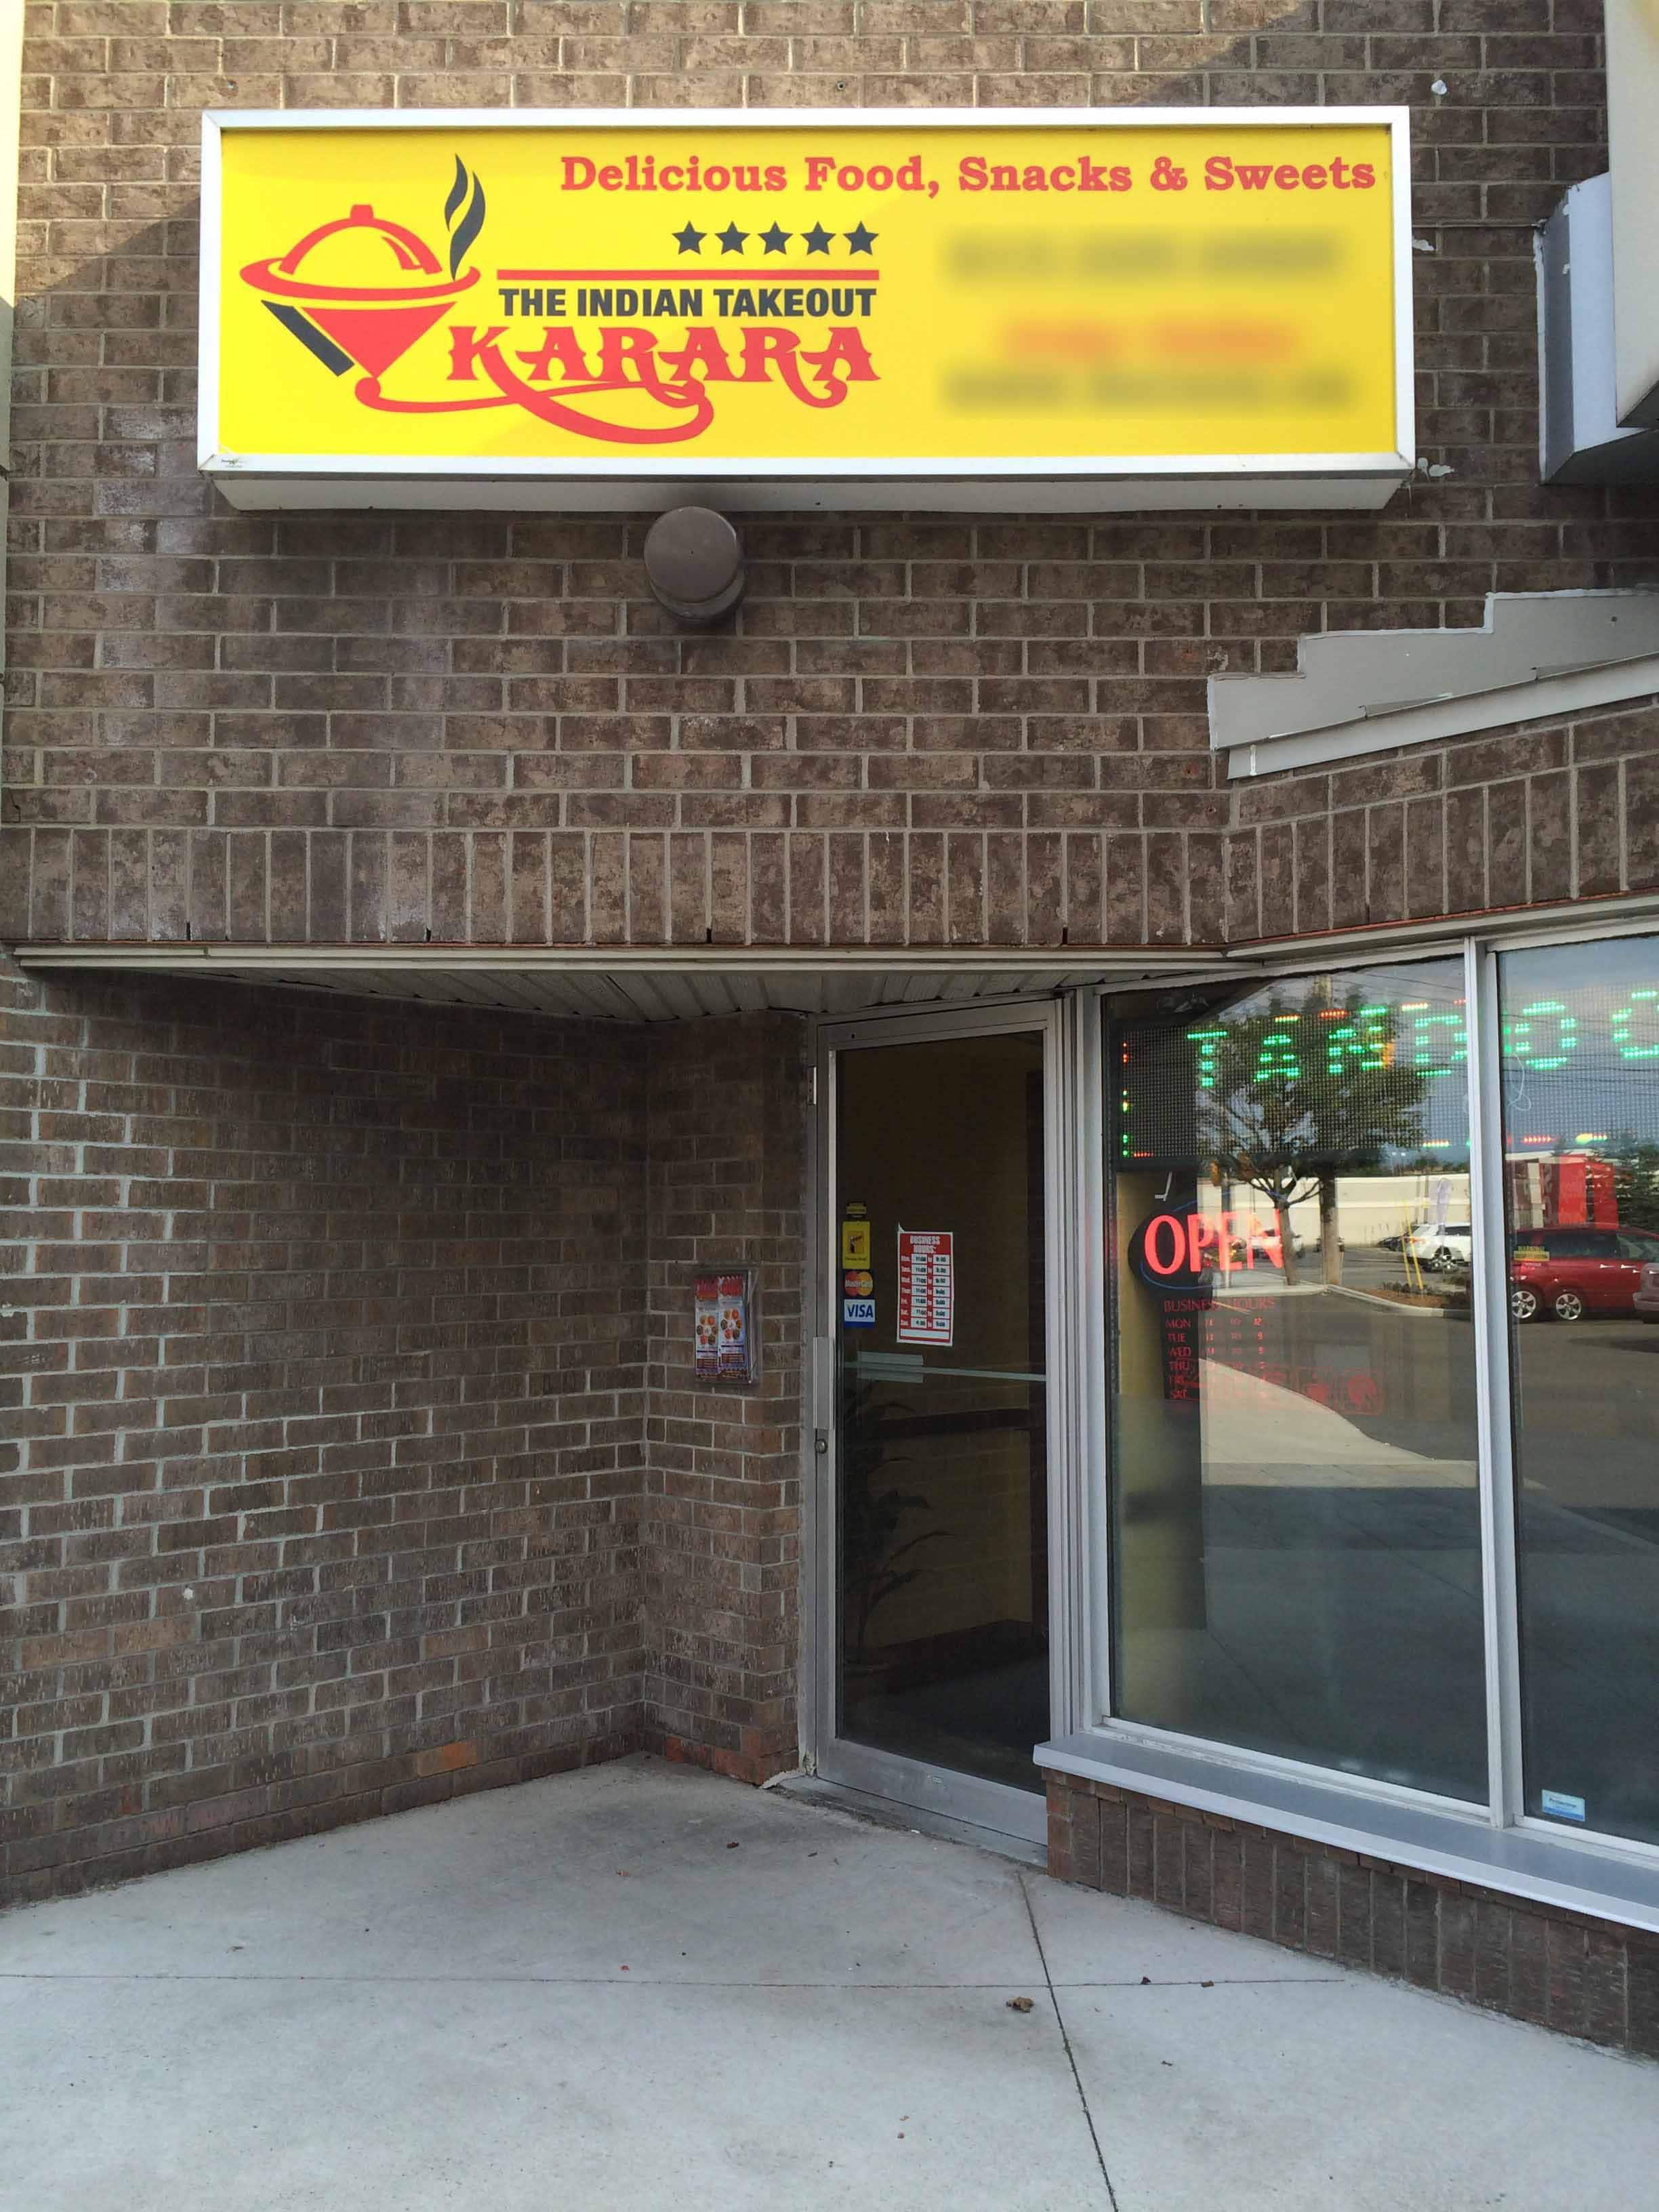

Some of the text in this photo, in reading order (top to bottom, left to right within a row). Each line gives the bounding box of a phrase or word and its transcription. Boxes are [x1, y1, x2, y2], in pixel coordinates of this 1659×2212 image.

[561, 155, 1376, 199] Delicious Food, Snacks & Sweets
[498, 288, 877, 317] THE INDIAN TAKEOUT
[447, 327, 880, 445] KARARA
[1144, 1208, 1284, 1275] OPEN
[846, 1304, 874, 1318] VISA
